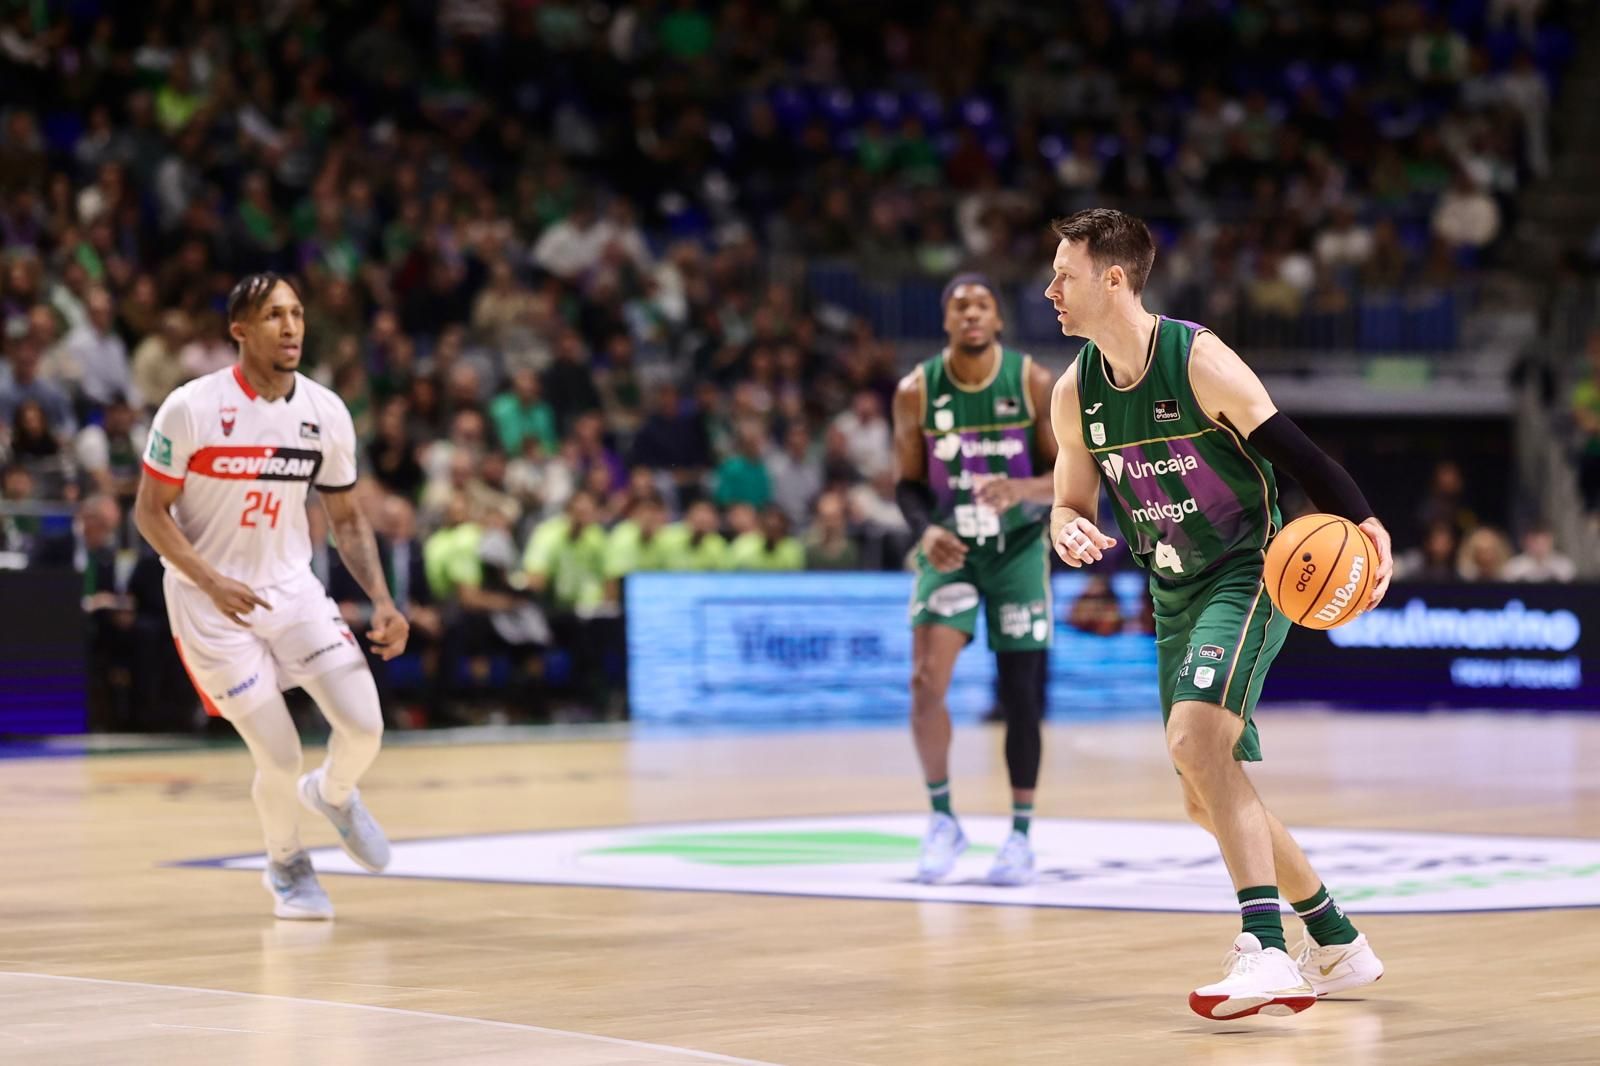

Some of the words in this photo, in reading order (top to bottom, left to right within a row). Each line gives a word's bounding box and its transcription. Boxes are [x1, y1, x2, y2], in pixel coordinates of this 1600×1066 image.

[240, 490, 282, 529] 24
[1155, 540, 1185, 574] 4
[1295, 563, 1317, 593] acb
[1313, 555, 1365, 622] Wilson
[1201, 650, 1218, 658] acb
